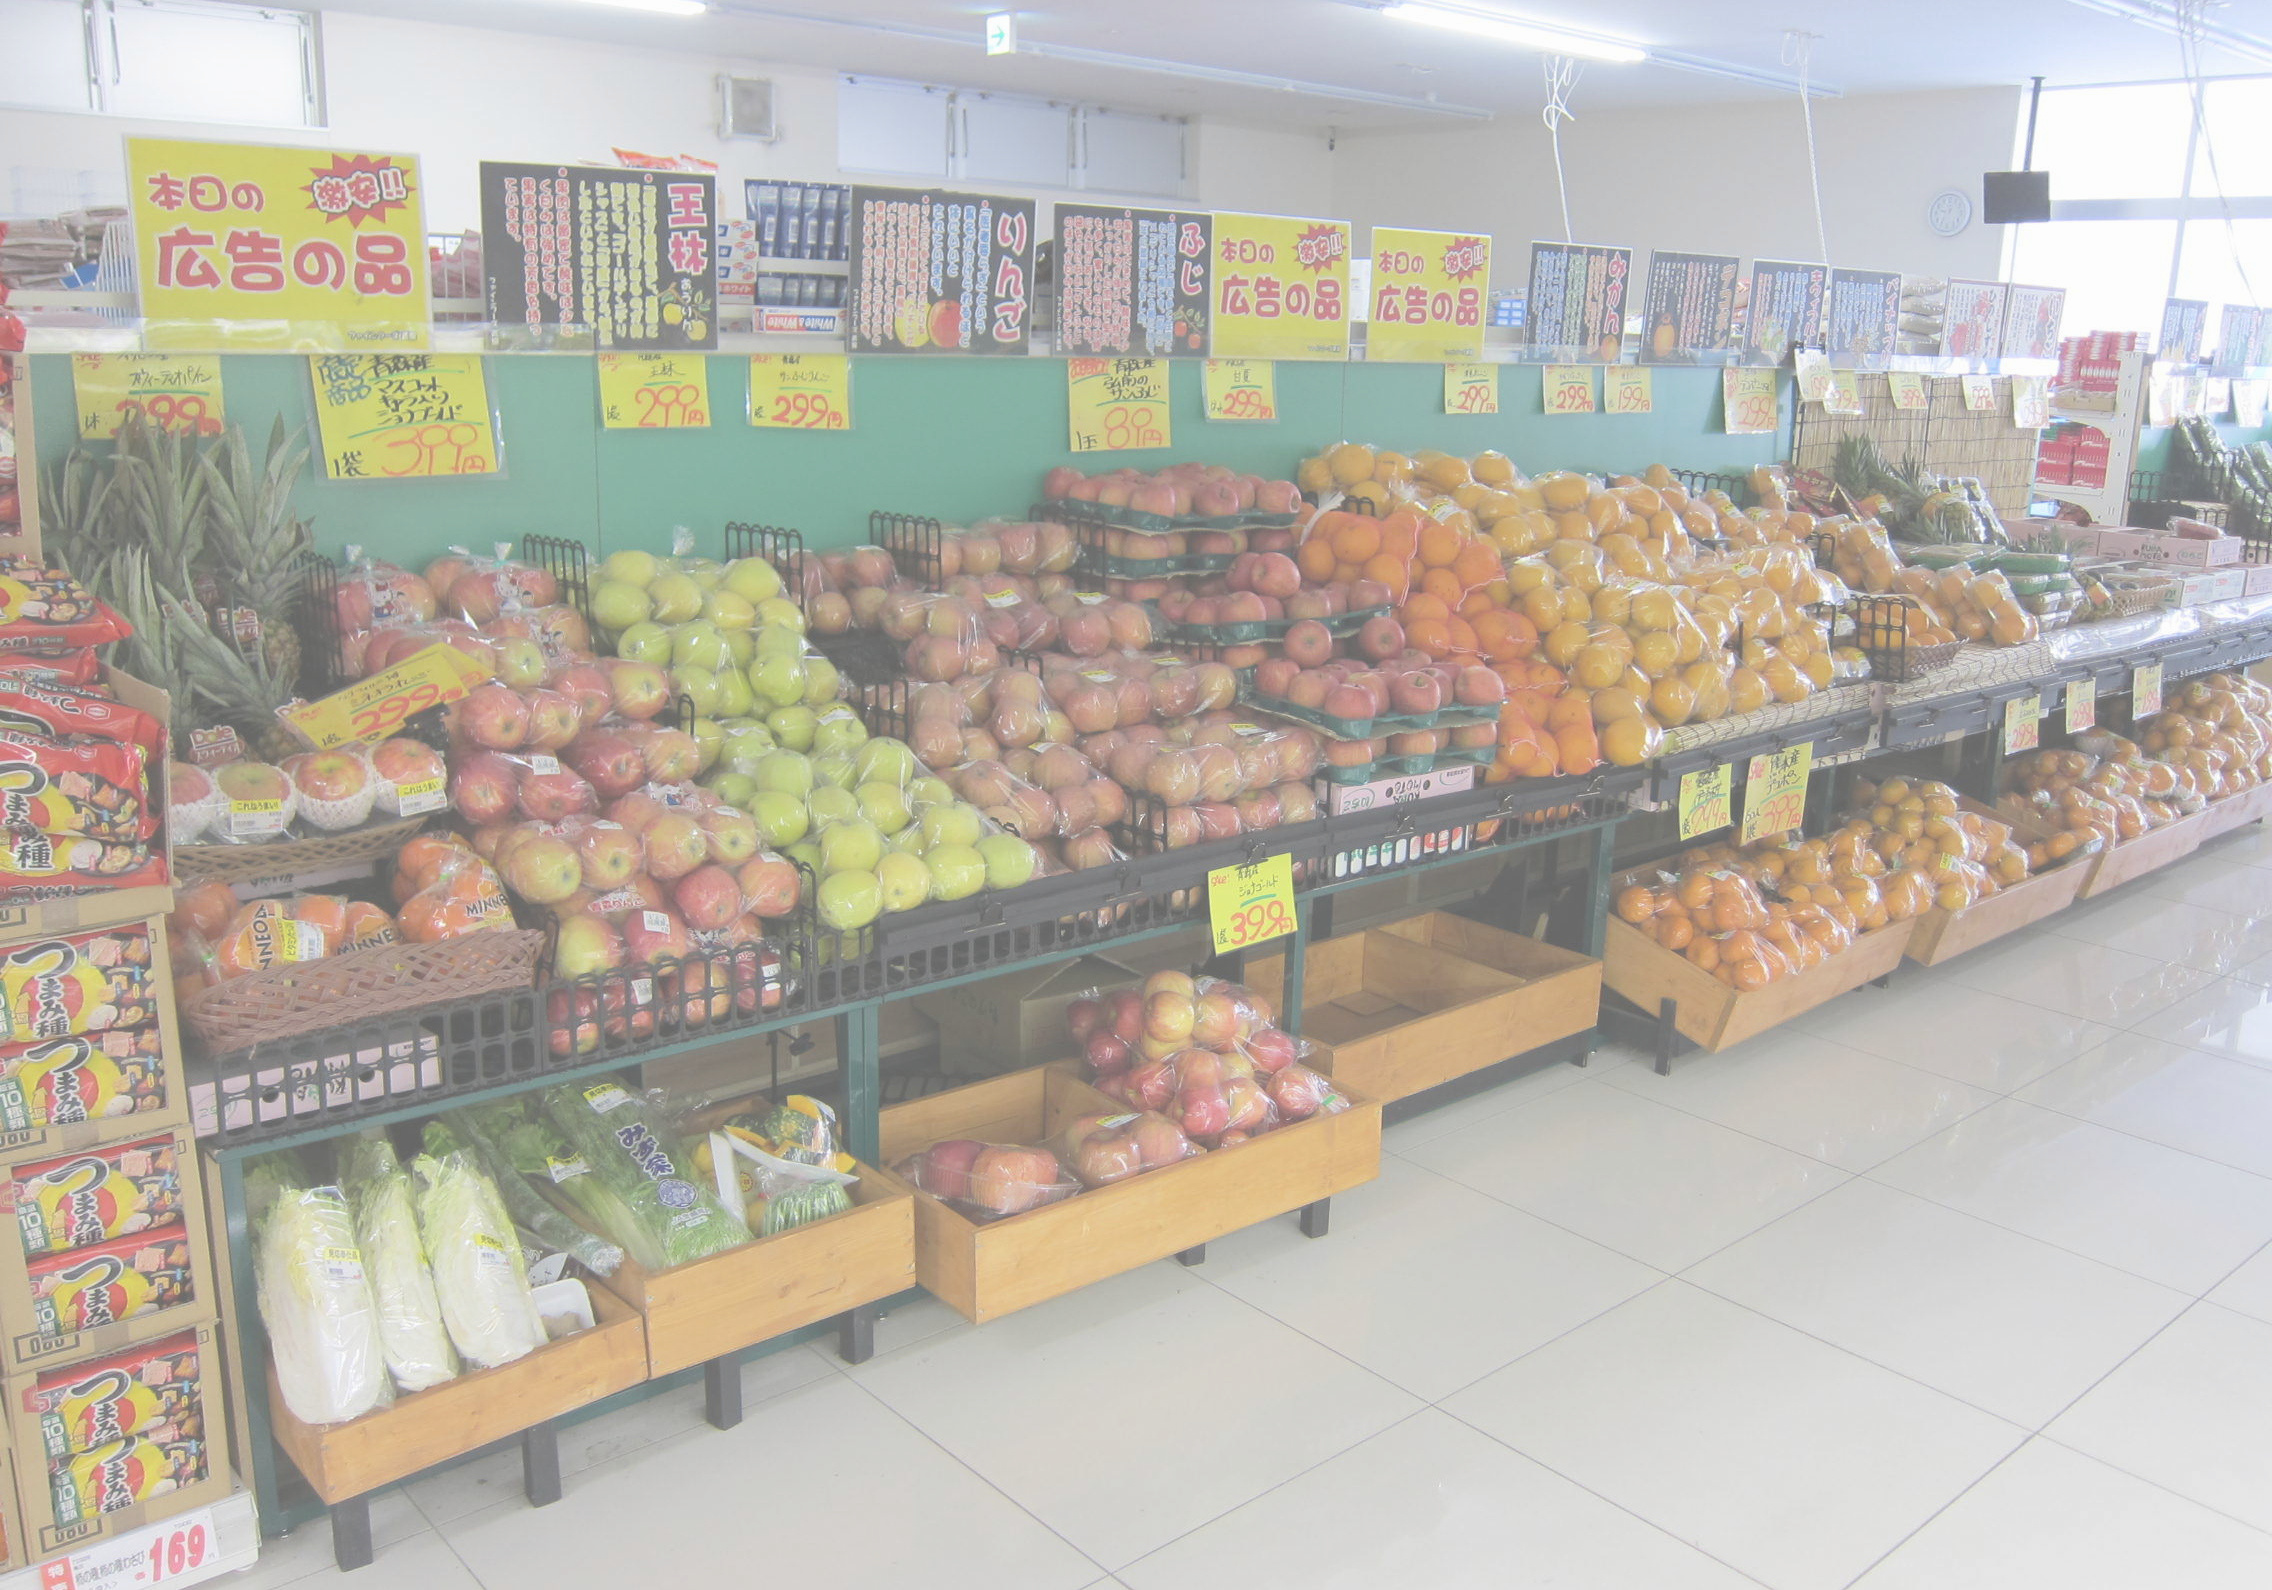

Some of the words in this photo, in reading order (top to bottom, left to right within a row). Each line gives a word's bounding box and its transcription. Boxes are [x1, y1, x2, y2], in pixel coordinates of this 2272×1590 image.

[147, 172, 265, 213] 本日の
[503, 177, 522, 243] ています。
[666, 182, 708, 276] 王林
[1219, 237, 1275, 264] 本日の
[156, 225, 414, 296] 広告の品
[992, 210, 1028, 343] りんご
[1178, 222, 1206, 296] ふじ
[1377, 249, 1426, 275] 本日の
[1219, 273, 1343, 322] 広告の品
[1374, 283, 1480, 327] 広告の品
[634, 383, 705, 428] 299円
[770, 392, 844, 429] 299円
[1222, 389, 1273, 419] 299円
[1456, 384, 1496, 413] 299円
[1103, 406, 1164, 449] 89円
[1229, 899, 1295, 946] 399円
[8, 940, 78, 1039] つまみ種
[149, 1524, 206, 1582] 169
